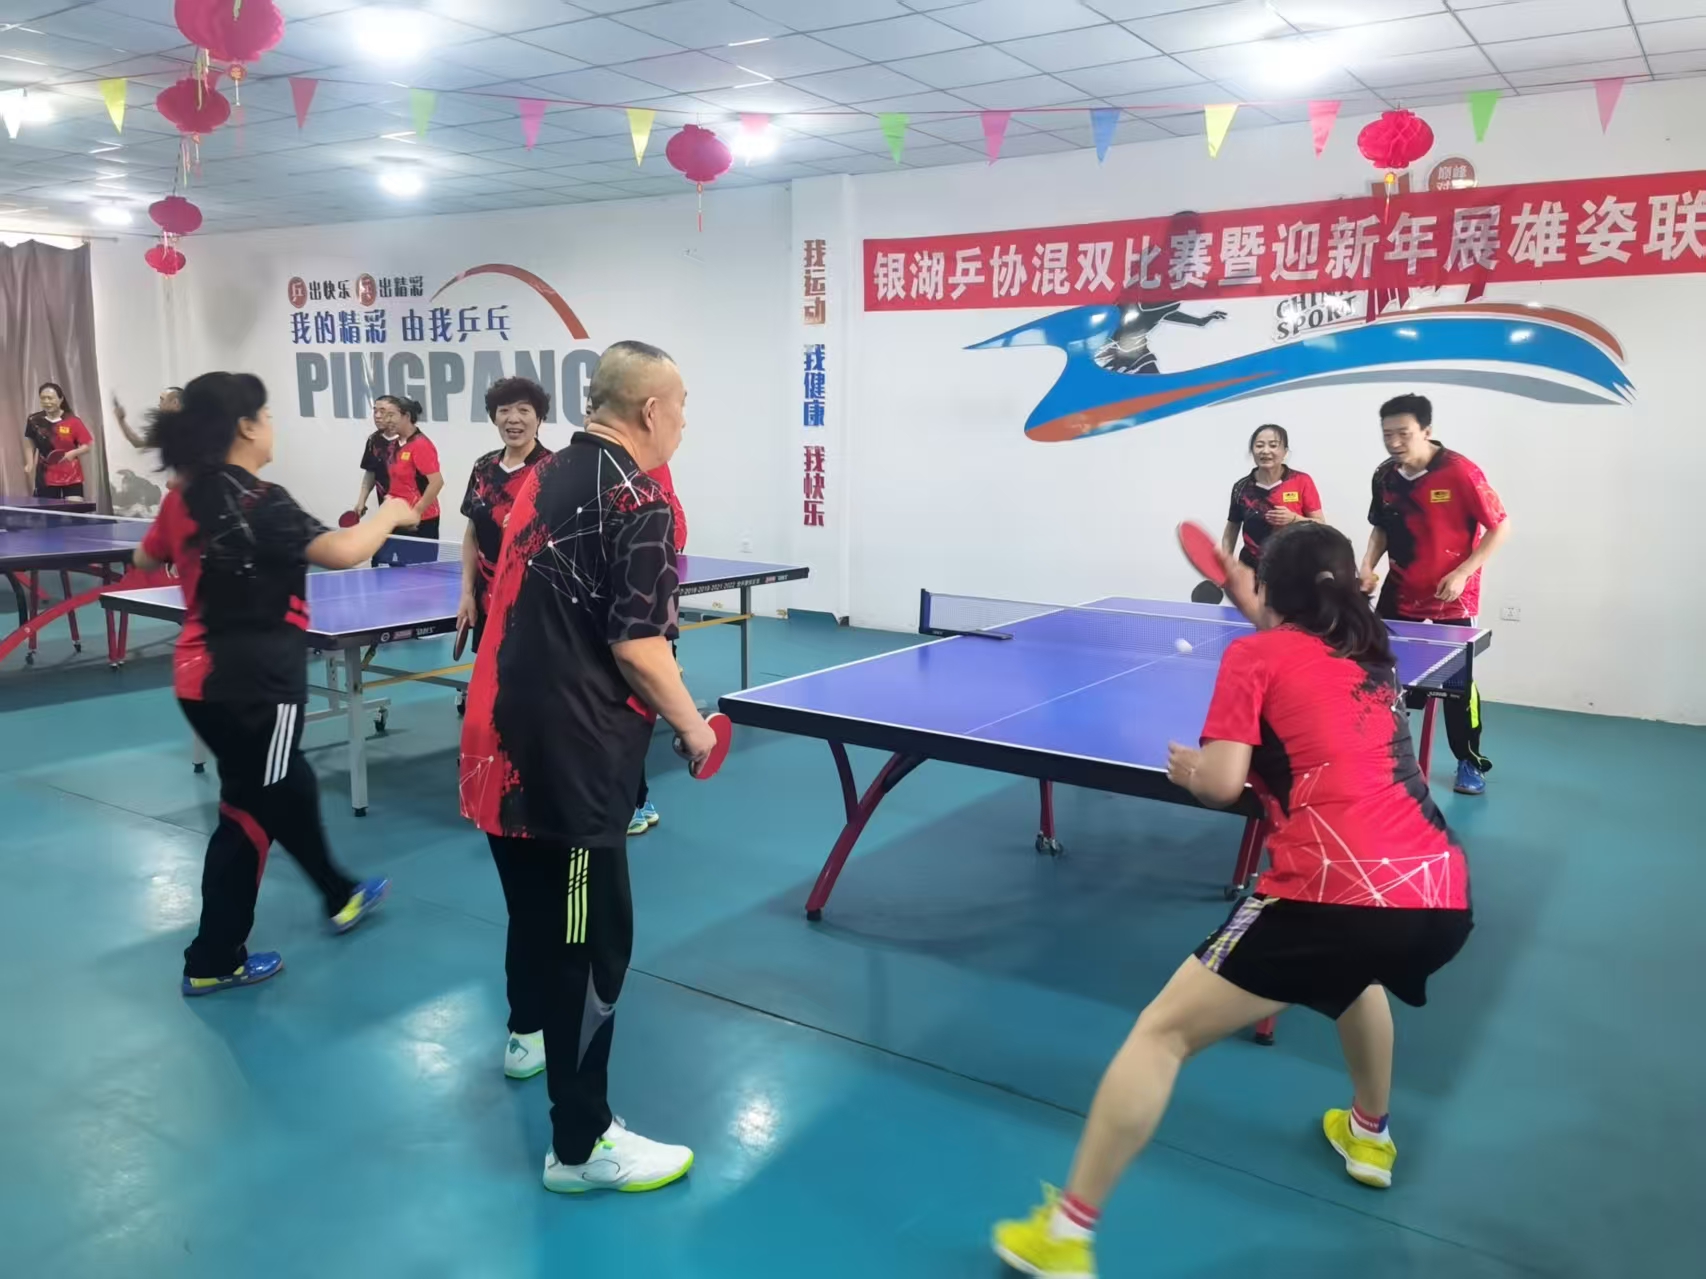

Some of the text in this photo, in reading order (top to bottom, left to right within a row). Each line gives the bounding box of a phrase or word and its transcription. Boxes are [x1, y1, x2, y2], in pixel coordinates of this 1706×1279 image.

[874, 189, 1706, 301] 银湖乒协混双比赛暨迎新年展雄姿联
[289, 278, 351, 302] 乒出快乐
[290, 305, 511, 344] 我的精彩 由我乒乓
[803, 239, 826, 527] 我运动 我健康 我快乐
